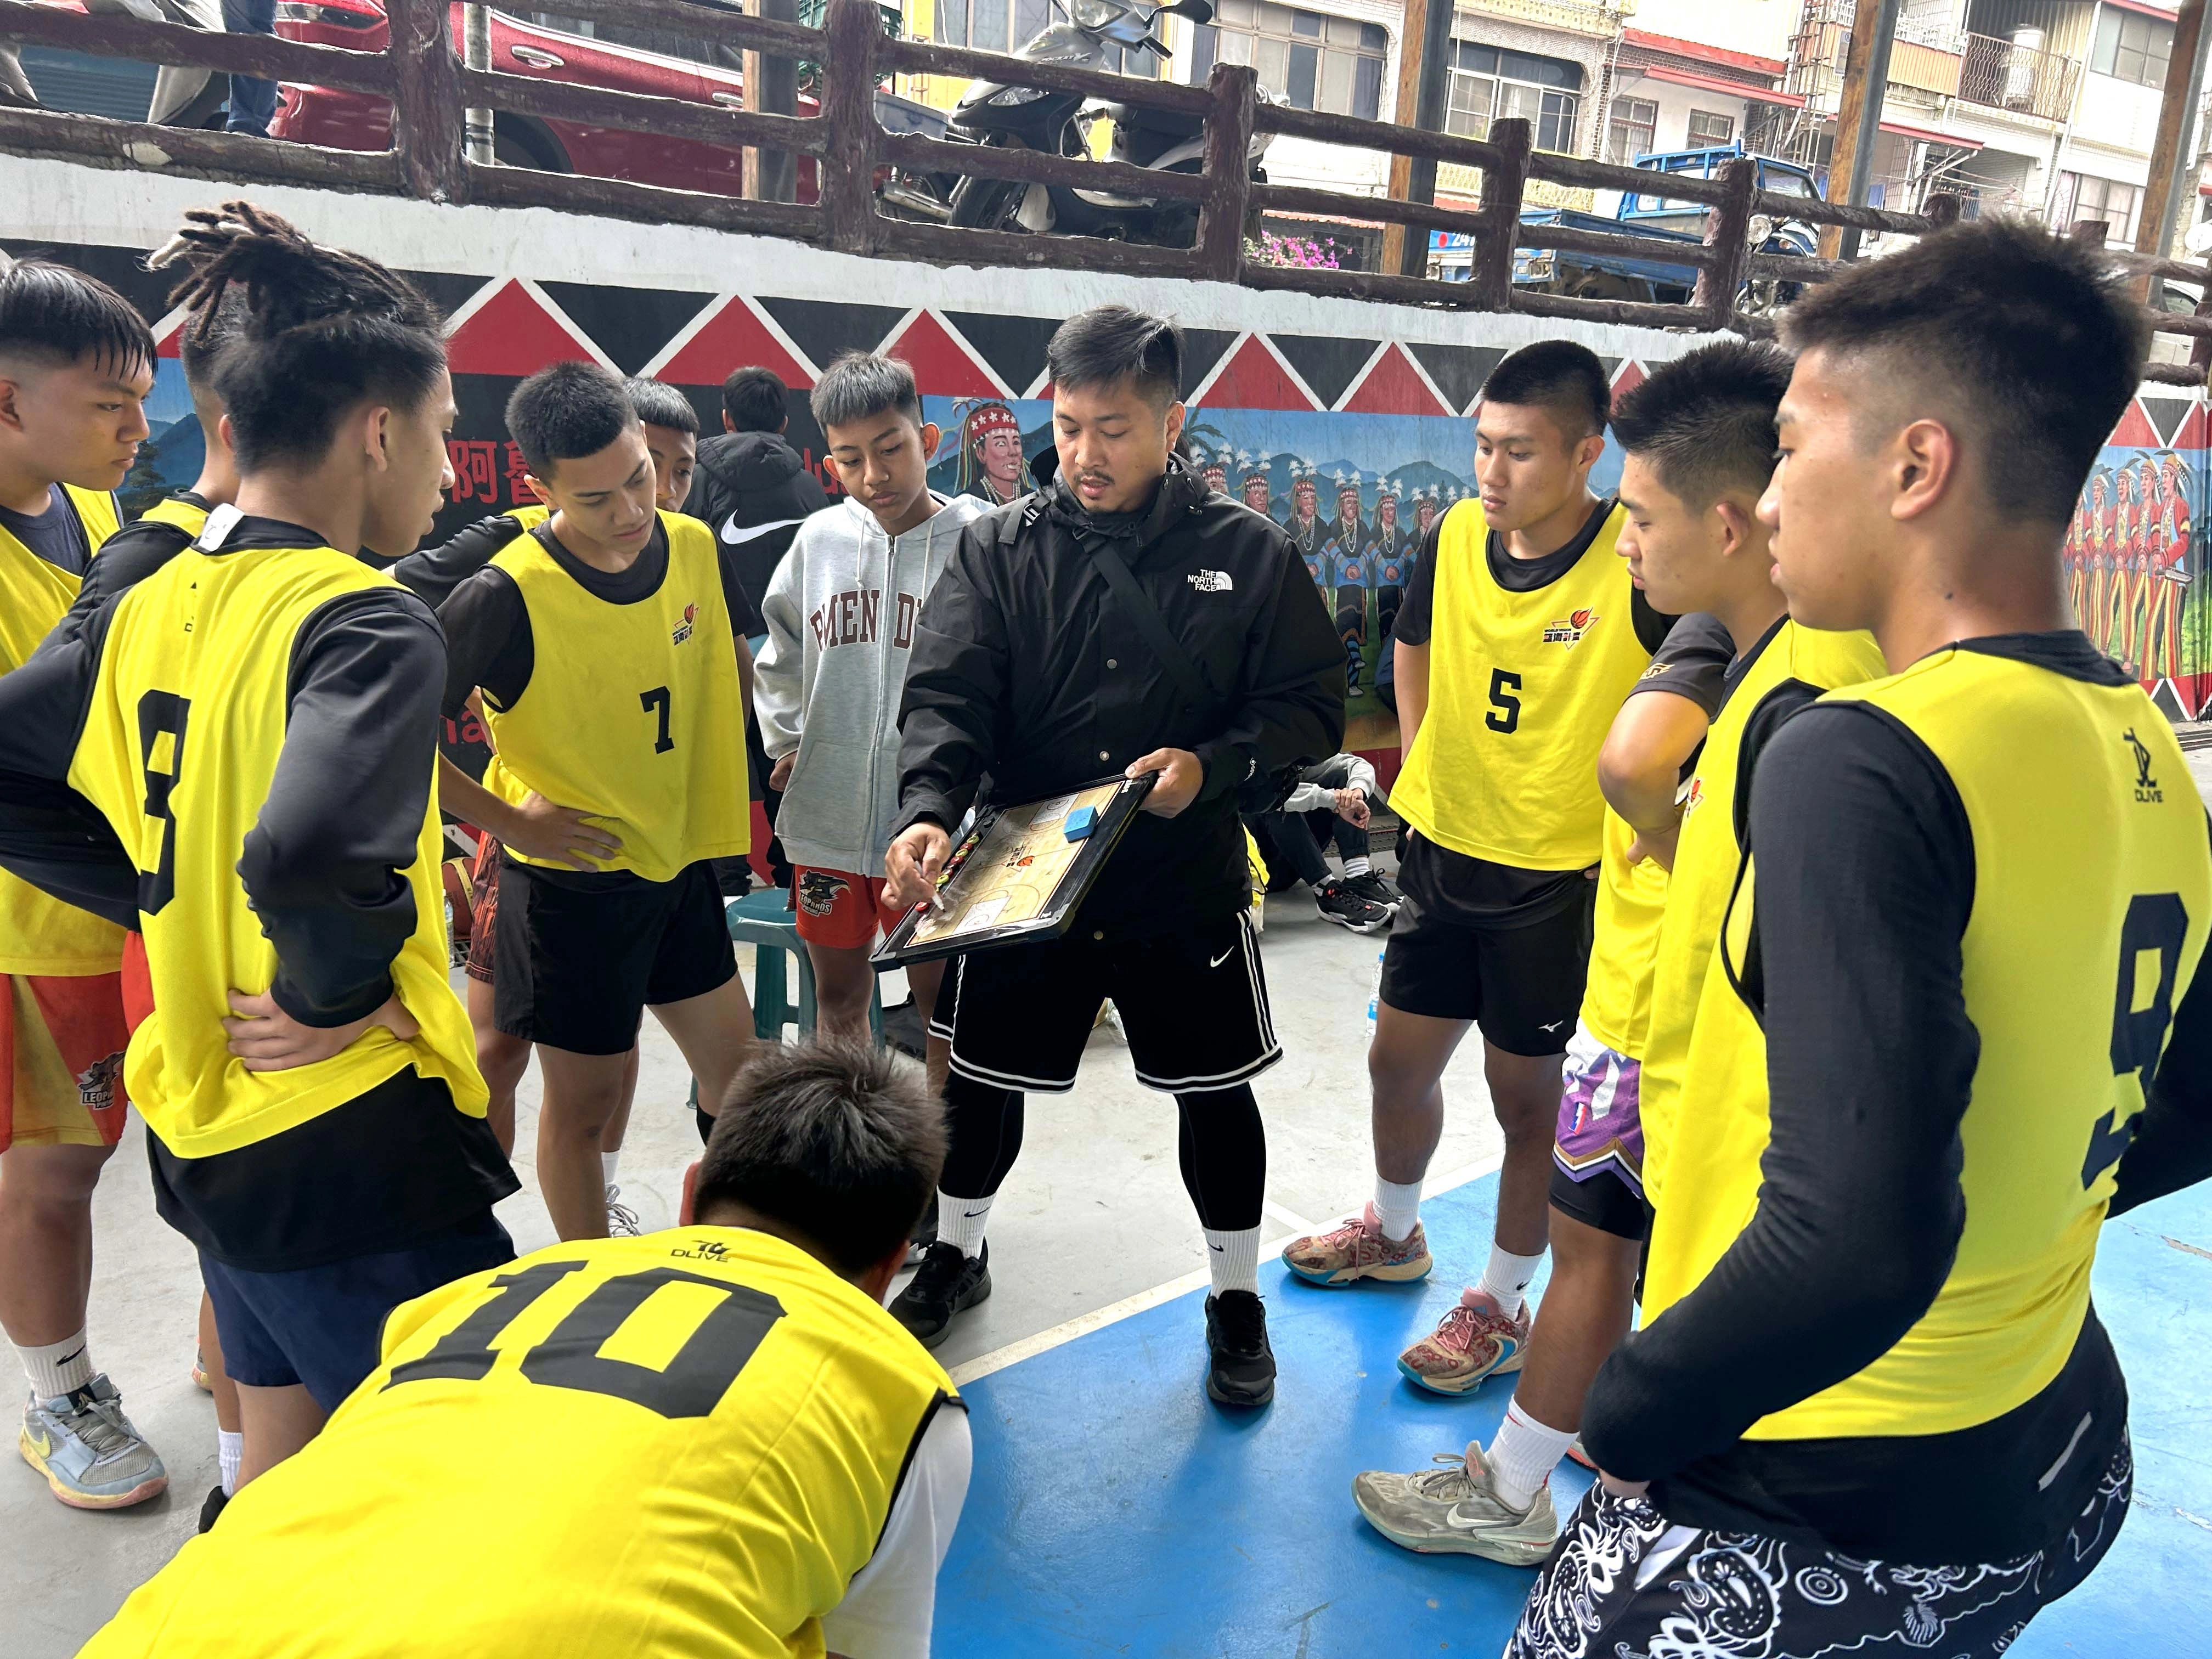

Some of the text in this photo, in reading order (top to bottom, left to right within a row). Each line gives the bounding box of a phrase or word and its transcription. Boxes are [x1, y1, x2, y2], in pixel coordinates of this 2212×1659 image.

[1187, 574, 1216, 585] NORTH
[1195, 583, 1217, 592] FACE
[1200, 569, 1216, 578] THE
[640, 686, 675, 755] 7
[1485, 668, 1522, 735] 5
[2080, 892, 2189, 1191] 9
[379, 1260, 788, 1419] 10
